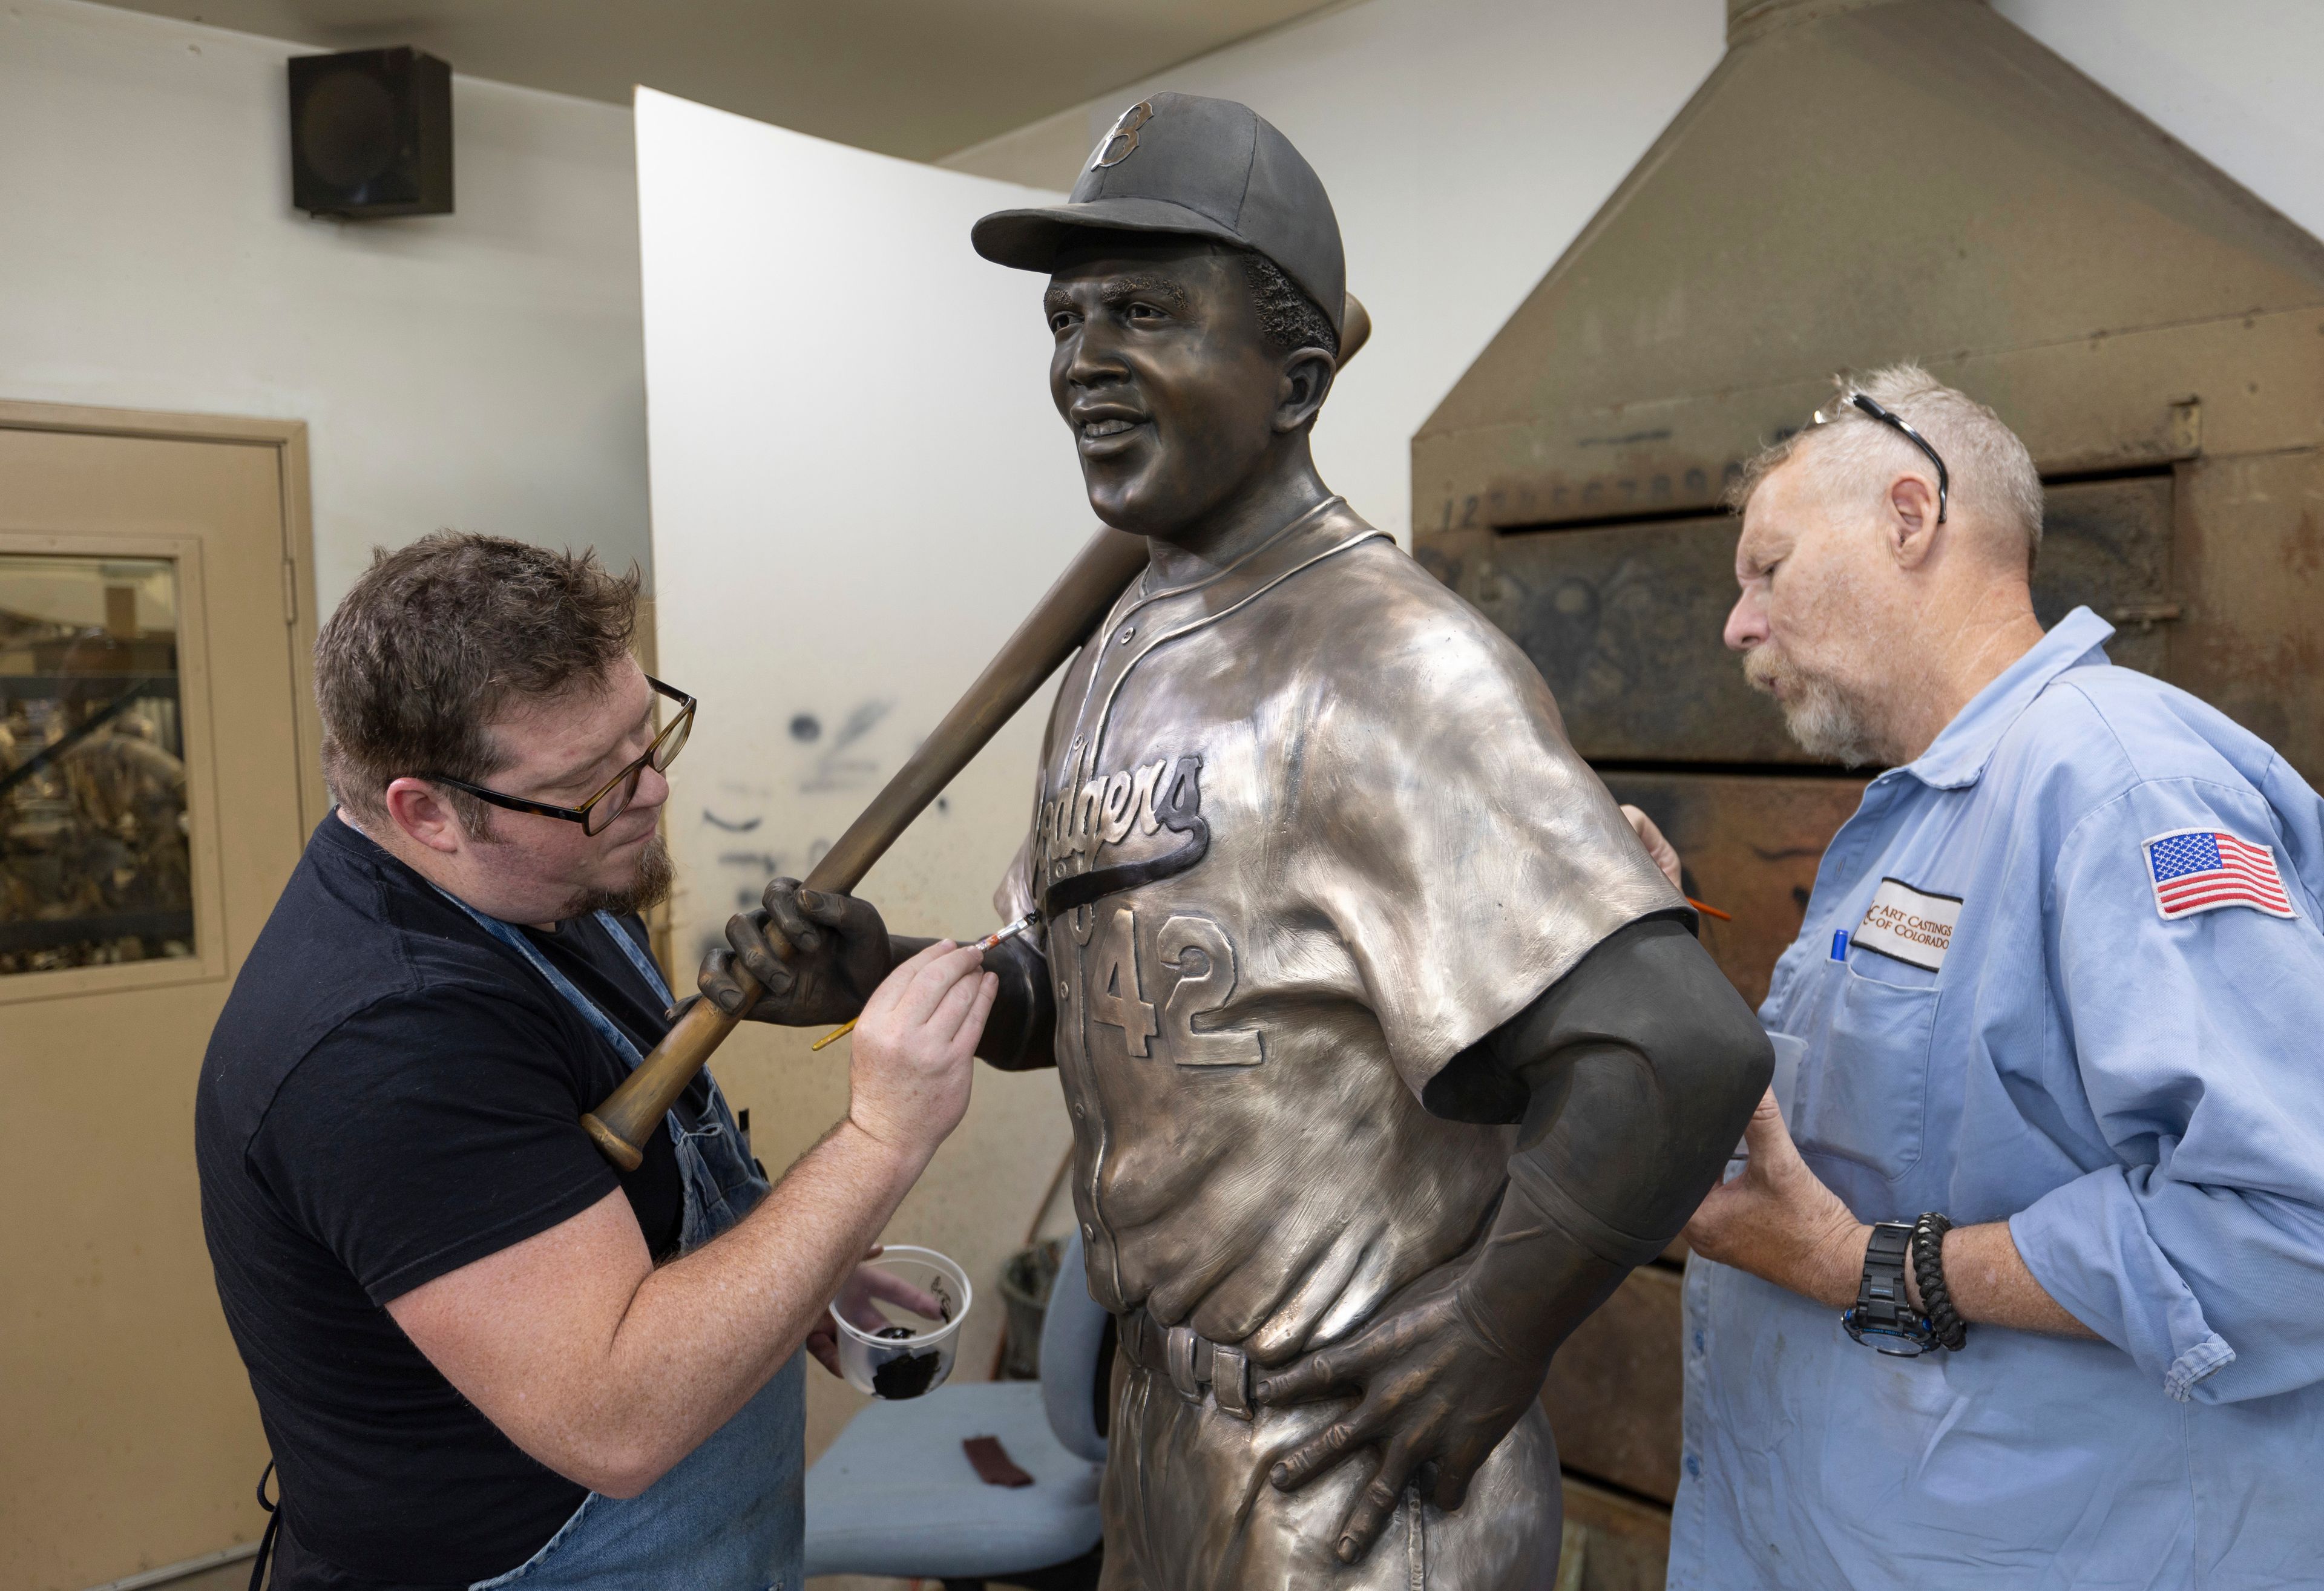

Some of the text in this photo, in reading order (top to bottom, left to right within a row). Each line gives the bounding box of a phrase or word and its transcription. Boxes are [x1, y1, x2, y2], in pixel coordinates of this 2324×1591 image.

[1091, 101, 1155, 172] B
[1876, 917, 1950, 950] OF COLORADO
[1880, 905, 1953, 937] ART CASTINGS
[1093, 908, 1265, 1066] 42
